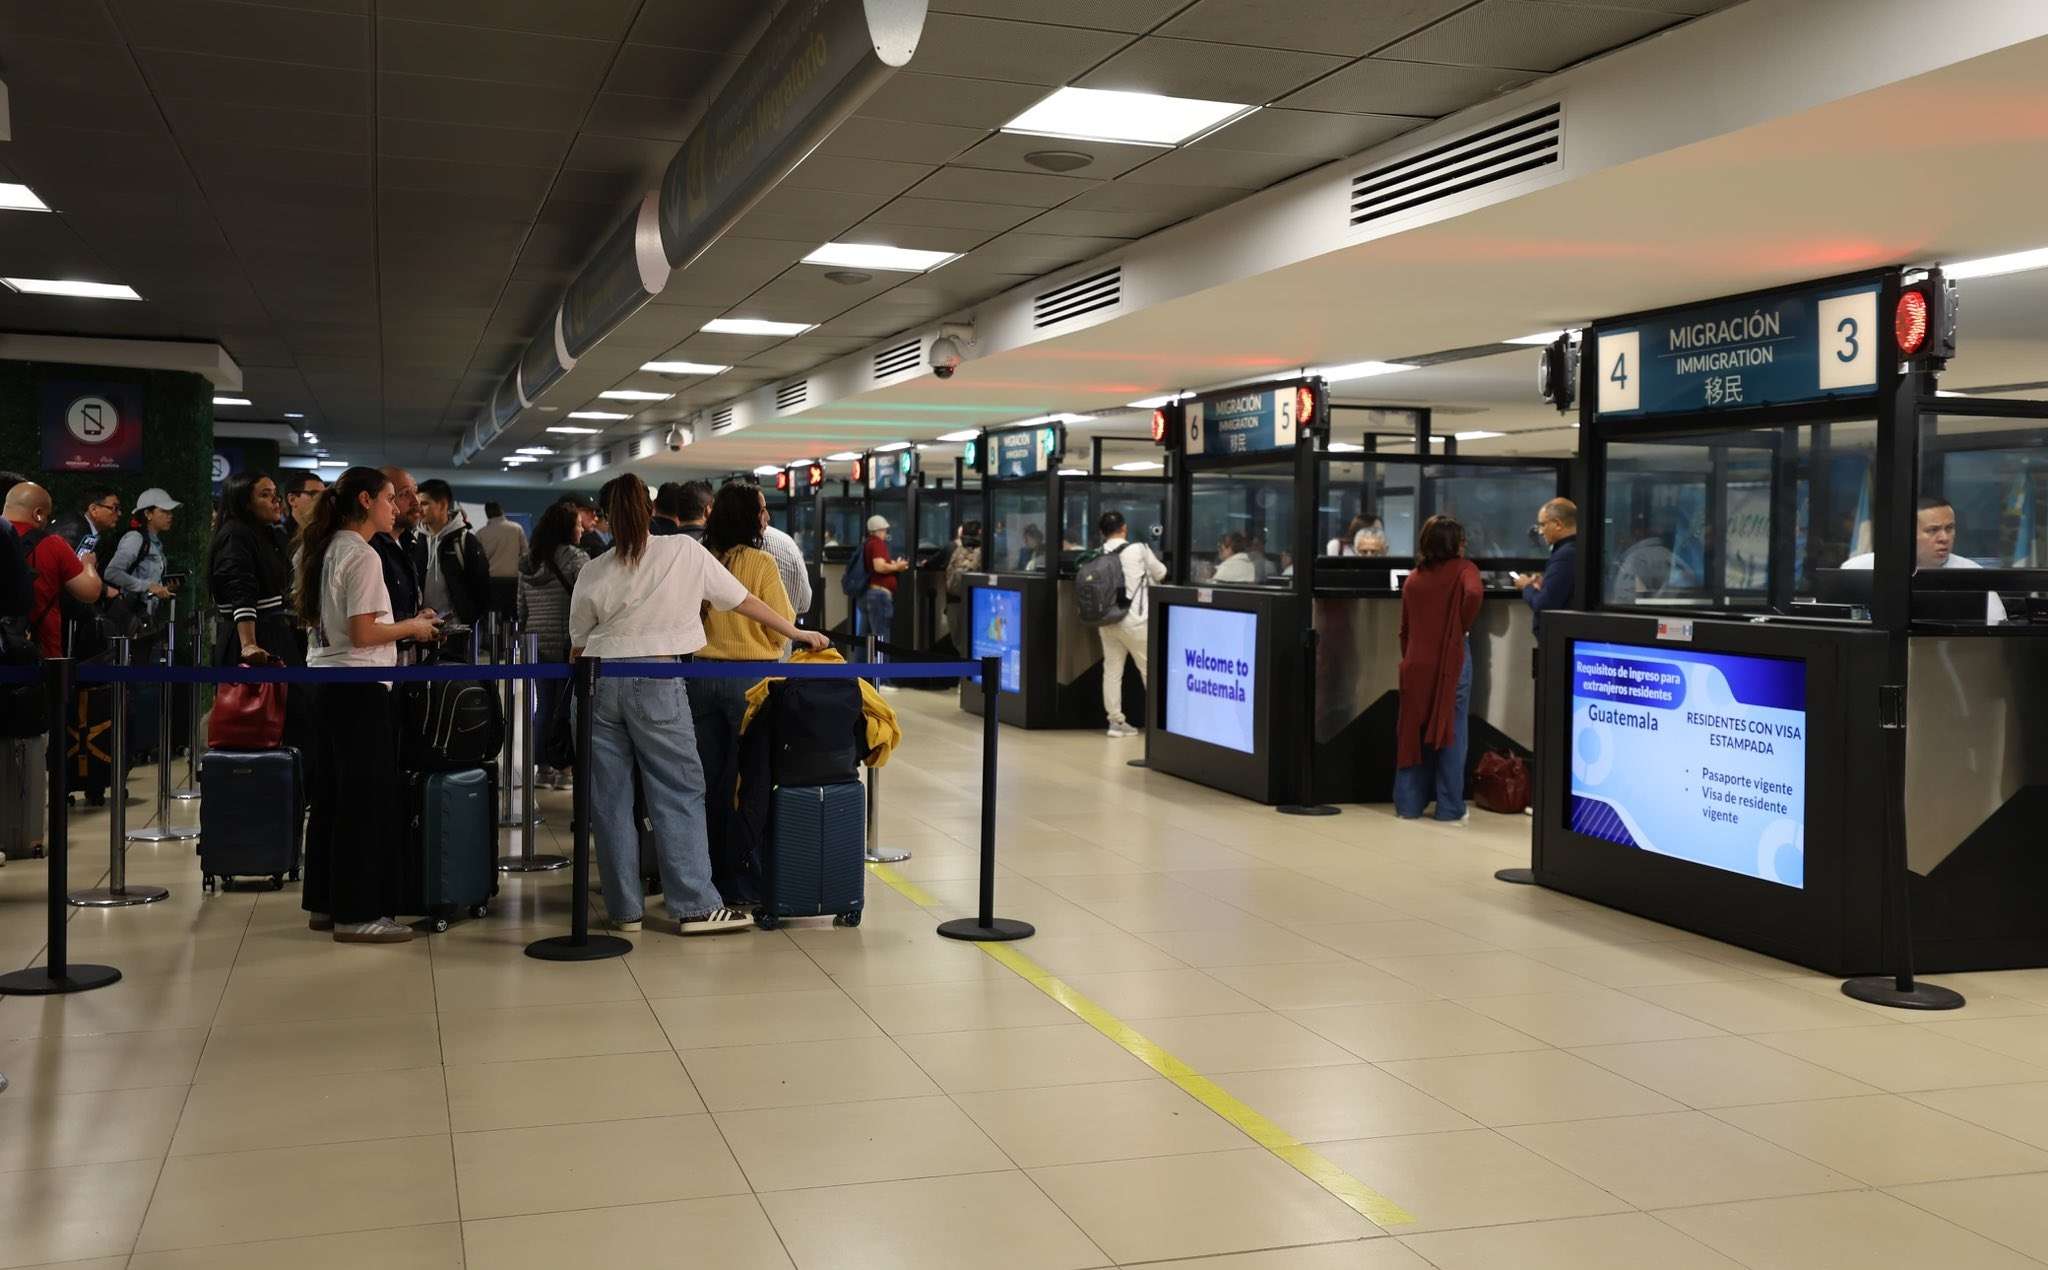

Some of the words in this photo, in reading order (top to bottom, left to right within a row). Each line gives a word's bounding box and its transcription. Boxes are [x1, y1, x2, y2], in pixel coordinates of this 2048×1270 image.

[1670, 309, 1780, 350] MIGRACIÓN
[1837, 317, 1859, 362] 3
[1610, 352, 1627, 390] 4
[1676, 346, 1773, 375] IMMIGRATION
[1705, 375, 1743, 405] 移民
[1191, 415, 1198, 440] 6
[1282, 402, 1290, 429] 5
[1185, 648, 1233, 673] Welcome
[1236, 659, 1248, 677] to
[1577, 661, 1617, 677] Requisitos
[1617, 665, 1628, 679] de
[1629, 666, 1660, 682] ingreso
[1660, 673, 1681, 685] para
[1186, 674, 1246, 703] Guatemala
[1583, 680, 1627, 696] extranjeros
[1628, 685, 1672, 701] residentes
[1588, 704, 1659, 731] Guatemala
[1687, 712, 1747, 732] RESIDENTES
[1748, 720, 1773, 736] CON
[1775, 724, 1802, 740] VISA
[1710, 733, 1774, 755] ESTAMPADA
[1702, 767, 1752, 788] Pasaporte
[1753, 777, 1793, 796] vigente
[1702, 786, 1722, 802] Visa
[1724, 791, 1736, 805] de
[1739, 796, 1788, 815] residente
[1702, 806, 1739, 824] vigente
